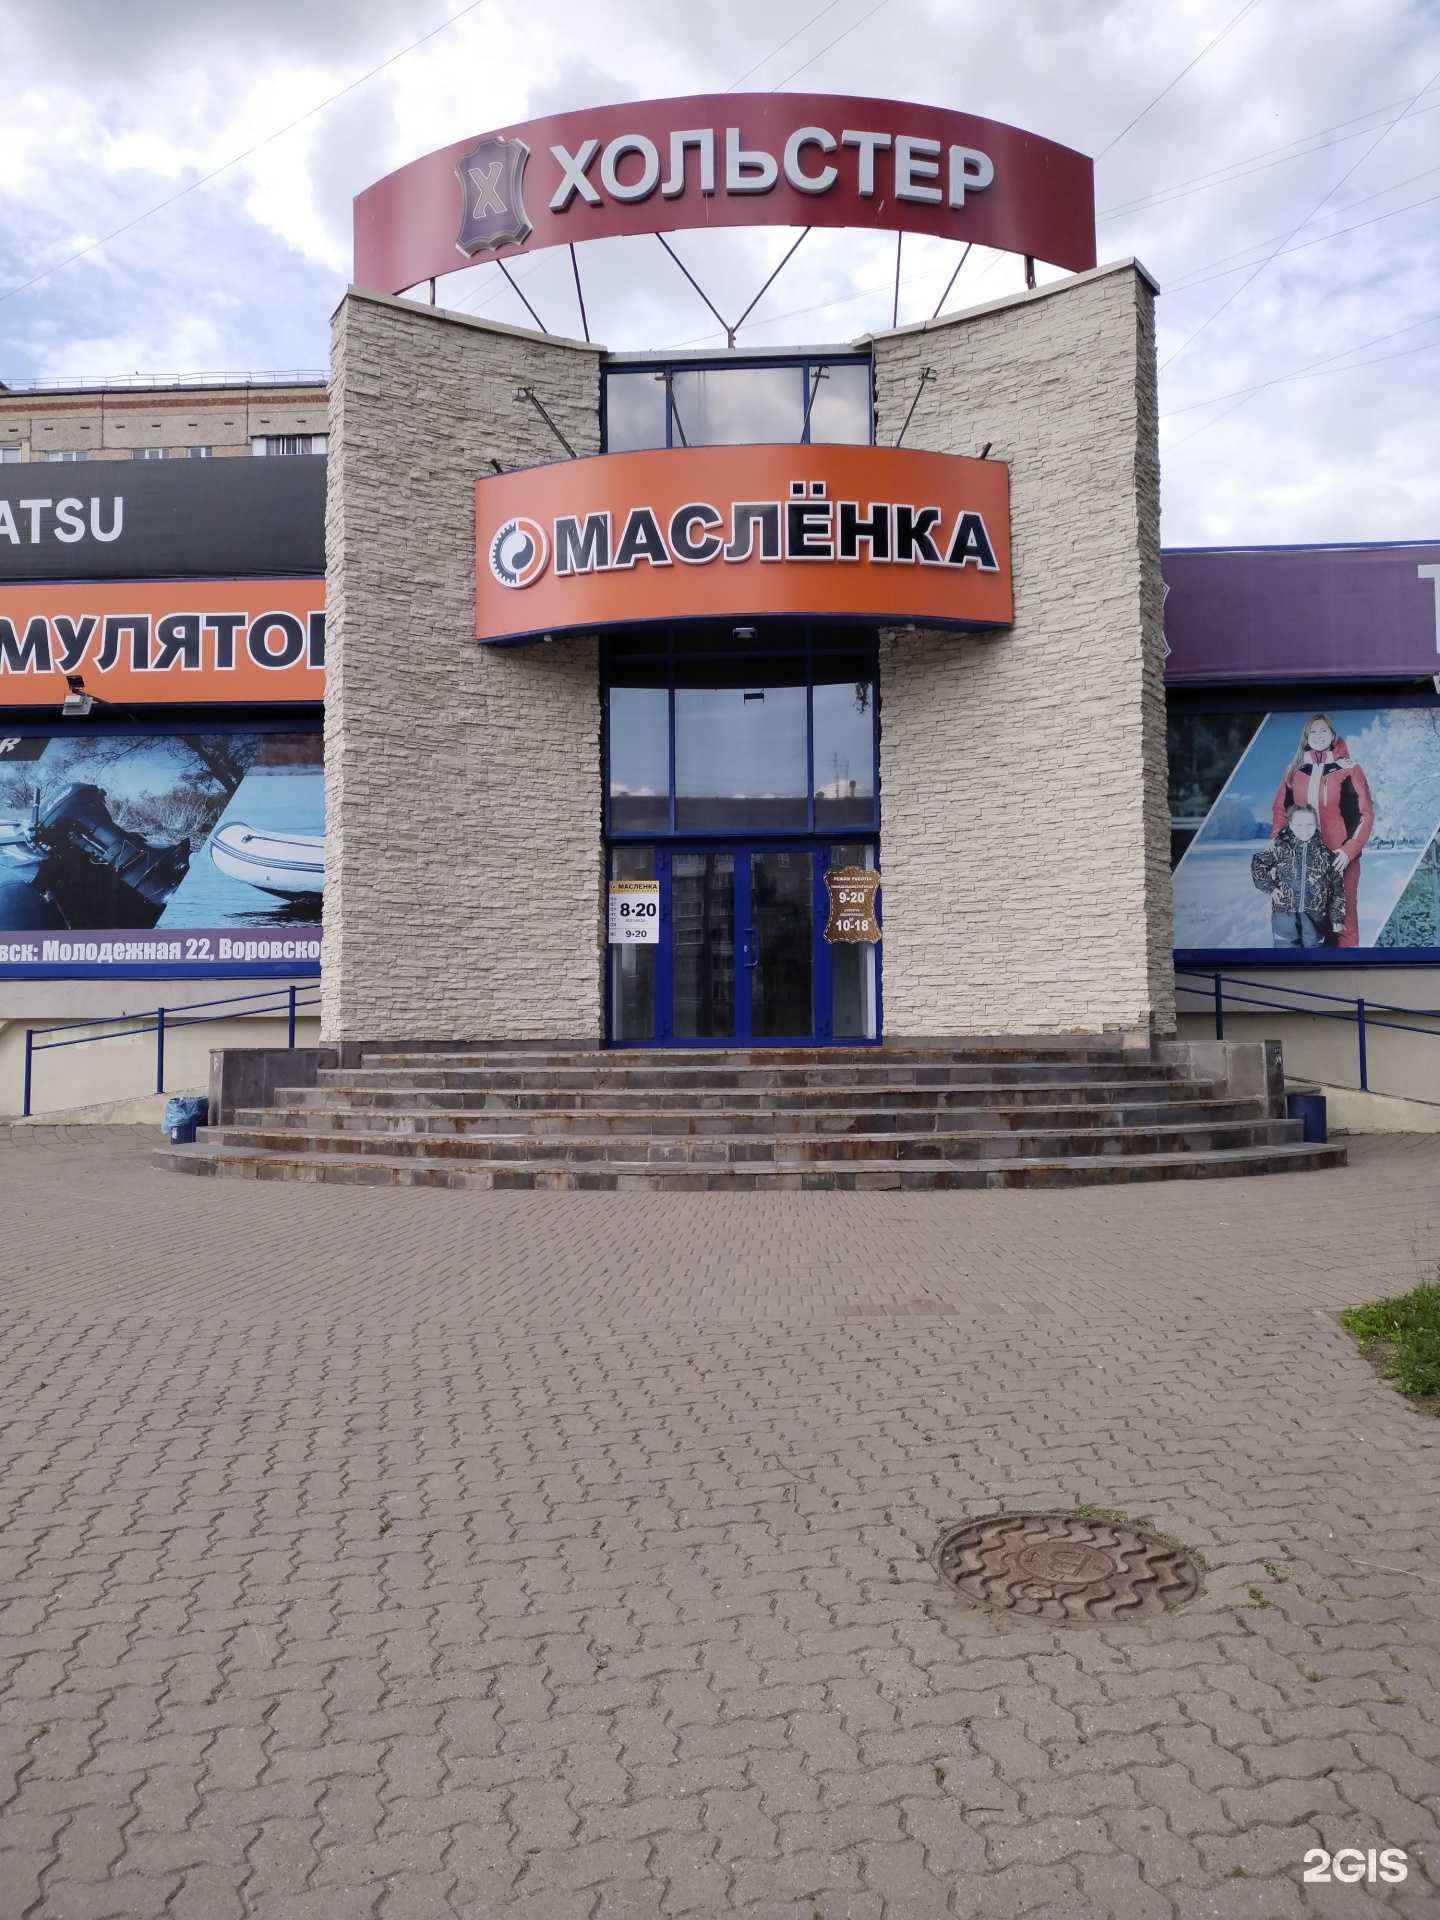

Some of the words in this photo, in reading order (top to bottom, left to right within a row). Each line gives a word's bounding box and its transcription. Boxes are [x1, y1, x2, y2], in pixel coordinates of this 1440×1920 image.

[548, 126, 995, 212] ХОЛЬСТЕР
[553, 480, 1001, 577] МАСЛЁНКА
[42, 938, 182, 963] Молодежная
[184, 938, 215, 962] 22,
[836, 919, 869, 932] 10-18
